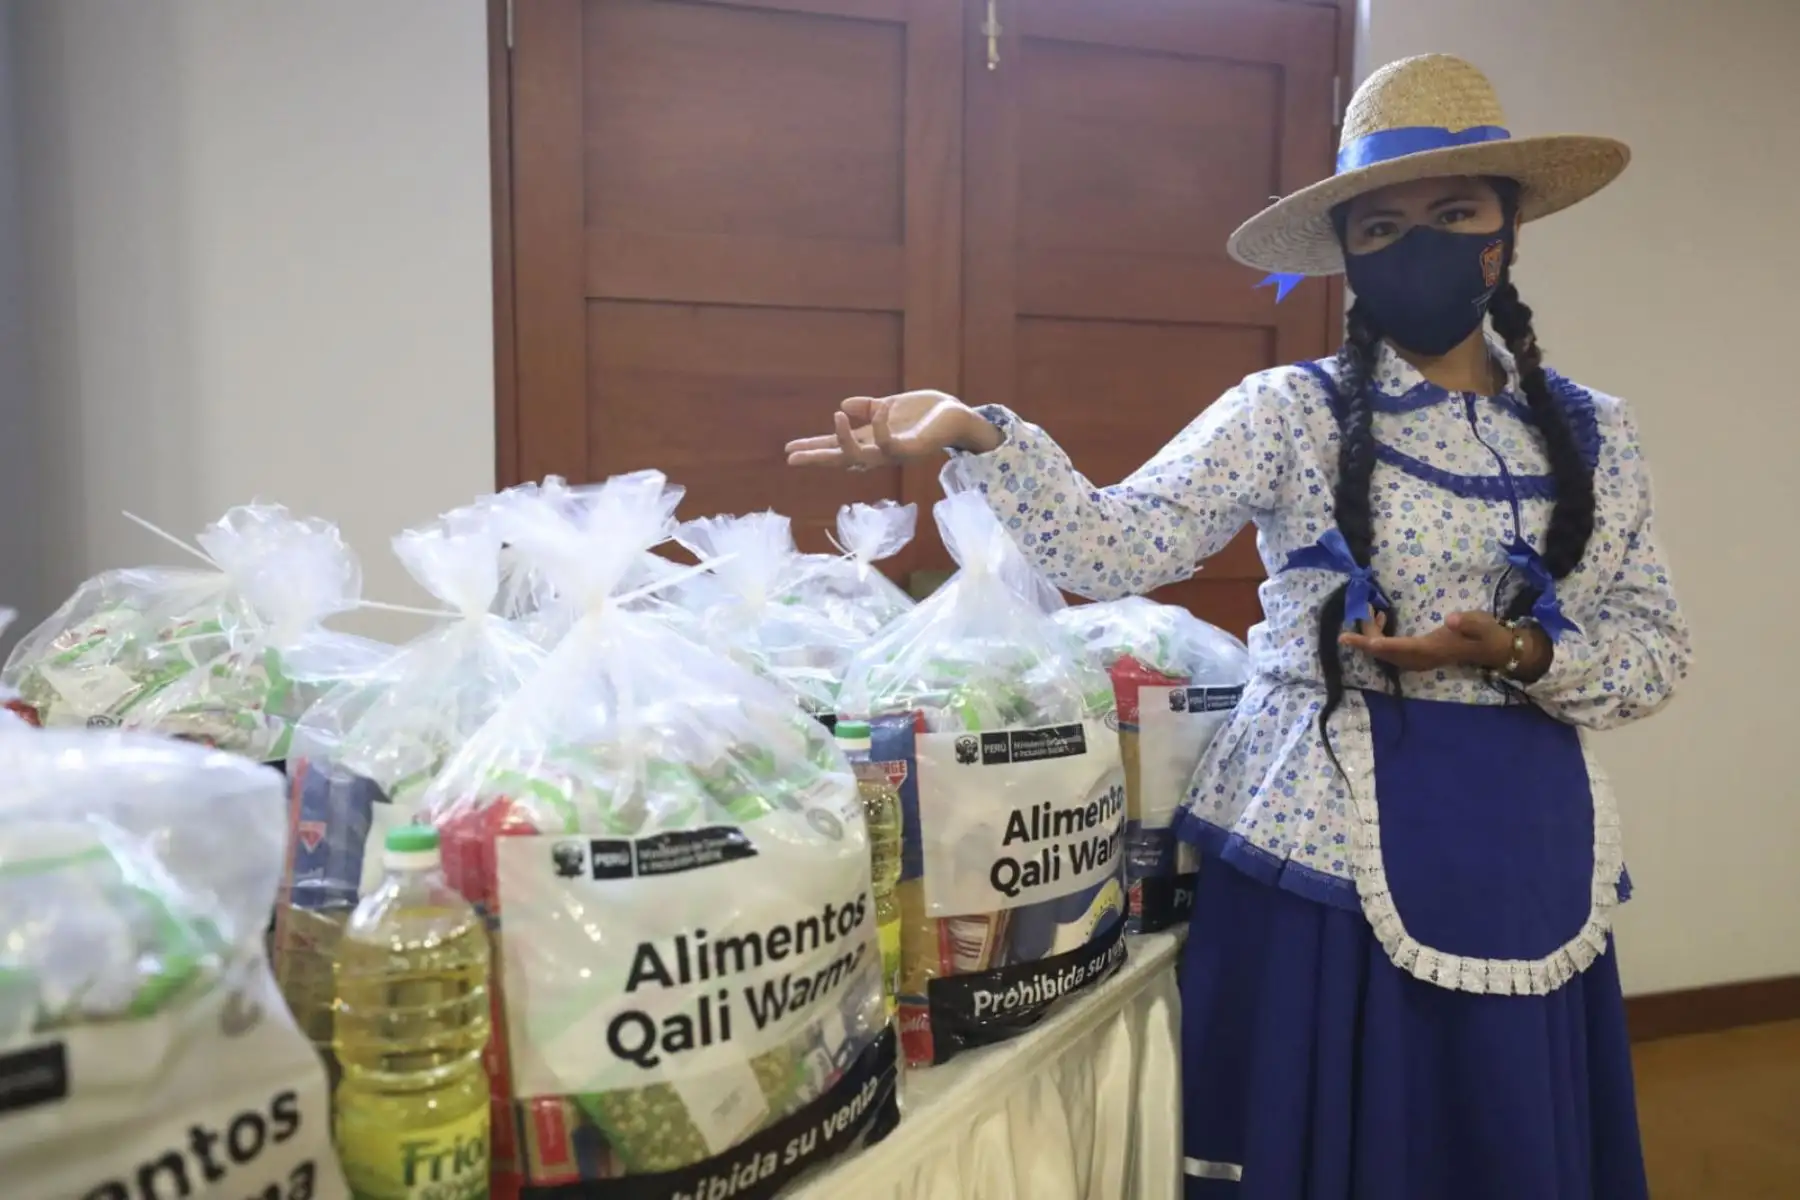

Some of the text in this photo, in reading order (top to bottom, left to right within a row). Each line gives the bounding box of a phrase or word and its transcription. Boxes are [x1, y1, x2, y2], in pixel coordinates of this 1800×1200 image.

[990, 844, 1061, 898] Qali
[624, 892, 867, 994] Alimentos
[972, 951, 1105, 1018] Prohibida su
[606, 990, 732, 1069] Qali
[400, 1131, 488, 1187] Frio
[784, 1125, 818, 1166] su
